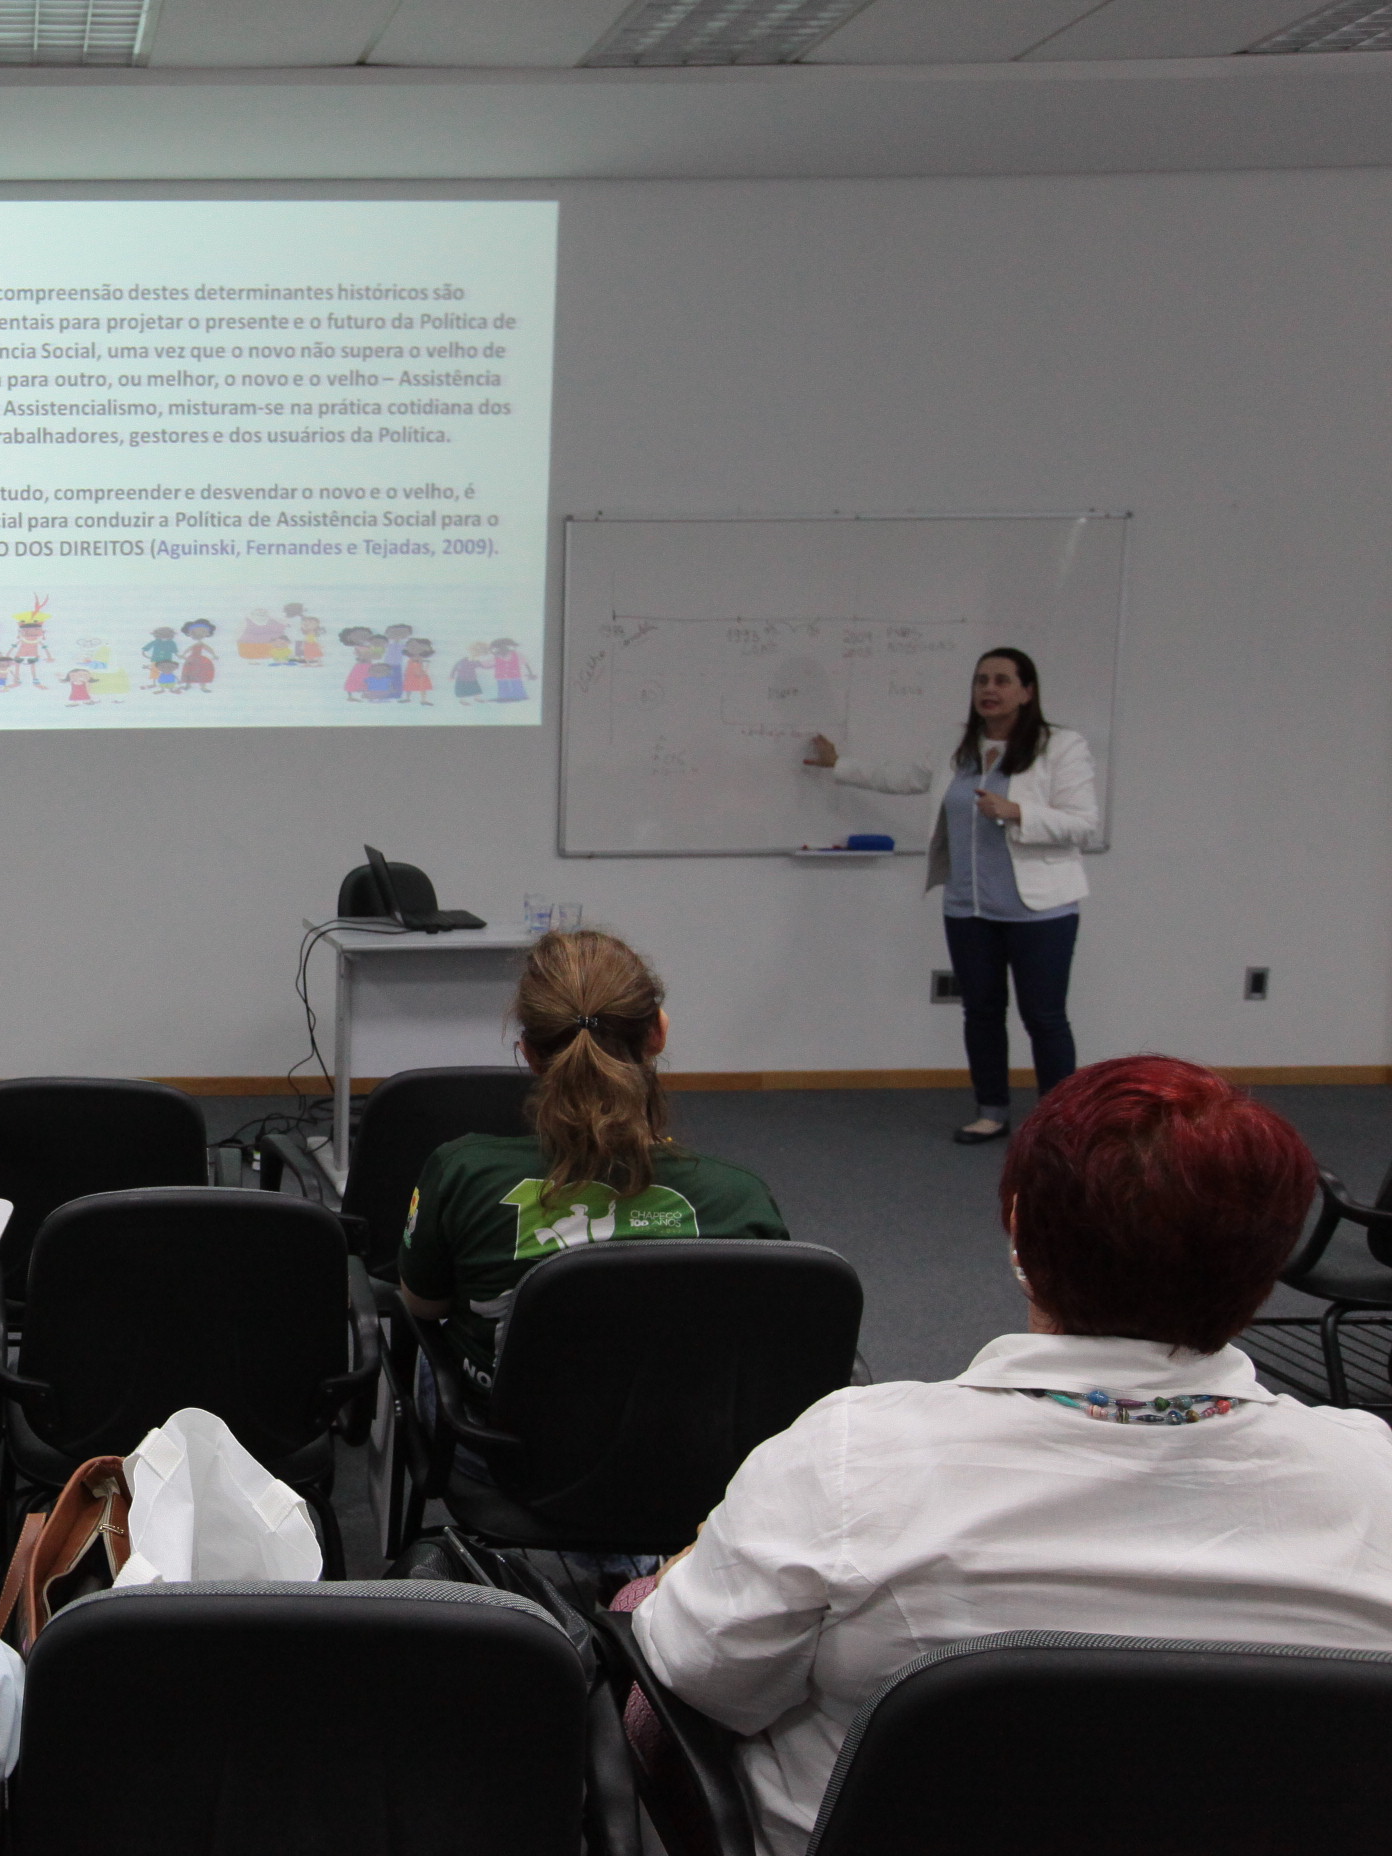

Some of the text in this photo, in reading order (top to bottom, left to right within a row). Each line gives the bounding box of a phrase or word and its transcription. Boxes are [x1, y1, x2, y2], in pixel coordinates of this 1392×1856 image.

[128, 283, 190, 301] destes
[194, 283, 334, 301] determinantes
[337, 283, 429, 301] históricos
[432, 283, 465, 301] são
[59, 317, 101, 334] para
[106, 313, 185, 334] projetar
[188, 317, 201, 330] o
[205, 315, 290, 334] presente
[293, 317, 305, 330] e
[309, 317, 322, 330] o
[326, 312, 386, 330] futuro
[390, 312, 414, 330] da
[420, 312, 488, 330] Política
[492, 313, 517, 330] de
[41, 341, 102, 362] Social,
[107, 346, 150, 359] uma
[154, 346, 186, 359] vez
[190, 346, 226, 362] que
[231, 346, 244, 359] o
[248, 346, 296, 359] novo
[300, 341, 336, 359] não
[340, 346, 405, 362] supera
[408, 346, 421, 359] o
[426, 341, 479, 359] velho
[482, 341, 506, 359] de
[7, 375, 50, 391] para
[54, 372, 113, 390] outro,
[118, 374, 142, 387] ou
[146, 370, 219, 389] melhor,
[224, 374, 236, 387] o
[241, 374, 289, 387] novo
[292, 374, 304, 387] e
[309, 374, 321, 387] o
[326, 369, 379, 387] velho
[399, 369, 502, 387] Assistência
[3, 398, 163, 418] Assistencialismo,
[168, 399, 285, 416] misturam-se
[290, 403, 313, 415] na
[318, 398, 382, 419] prática
[387, 398, 474, 415] cotidiana
[478, 398, 512, 415] dos
[129, 428, 209, 447] gestores
[212, 431, 224, 443] e
[228, 426, 262, 443] dos
[267, 426, 346, 443] usuários
[350, 426, 373, 443] da
[378, 426, 451, 443] Política.
[54, 483, 182, 504] compreender
[184, 488, 196, 500] e
[200, 483, 299, 500] desvendar
[301, 487, 314, 500] o
[319, 487, 366, 500] novo
[369, 487, 381, 500] e
[385, 487, 398, 500] o
[402, 482, 460, 502] velho,
[464, 483, 476, 499] é
[27, 516, 69, 533] para
[74, 511, 156, 528] conduzir
[158, 515, 169, 528] a
[175, 511, 242, 528] Política
[248, 511, 271, 527] de
[276, 510, 378, 527] Assistência
[382, 510, 437, 527] Social
[441, 514, 482, 530] para
[487, 514, 499, 527] o
[14, 540, 54, 557] DOS
[59, 540, 145, 557] DIREITOS
[150, 538, 241, 560] (Aguinski,
[246, 539, 343, 555] Fernandes
[346, 543, 358, 555] e
[363, 538, 436, 559] Tejadas,
[442, 538, 498, 558] 2009).
[651, 1218, 681, 1228] ANOS
